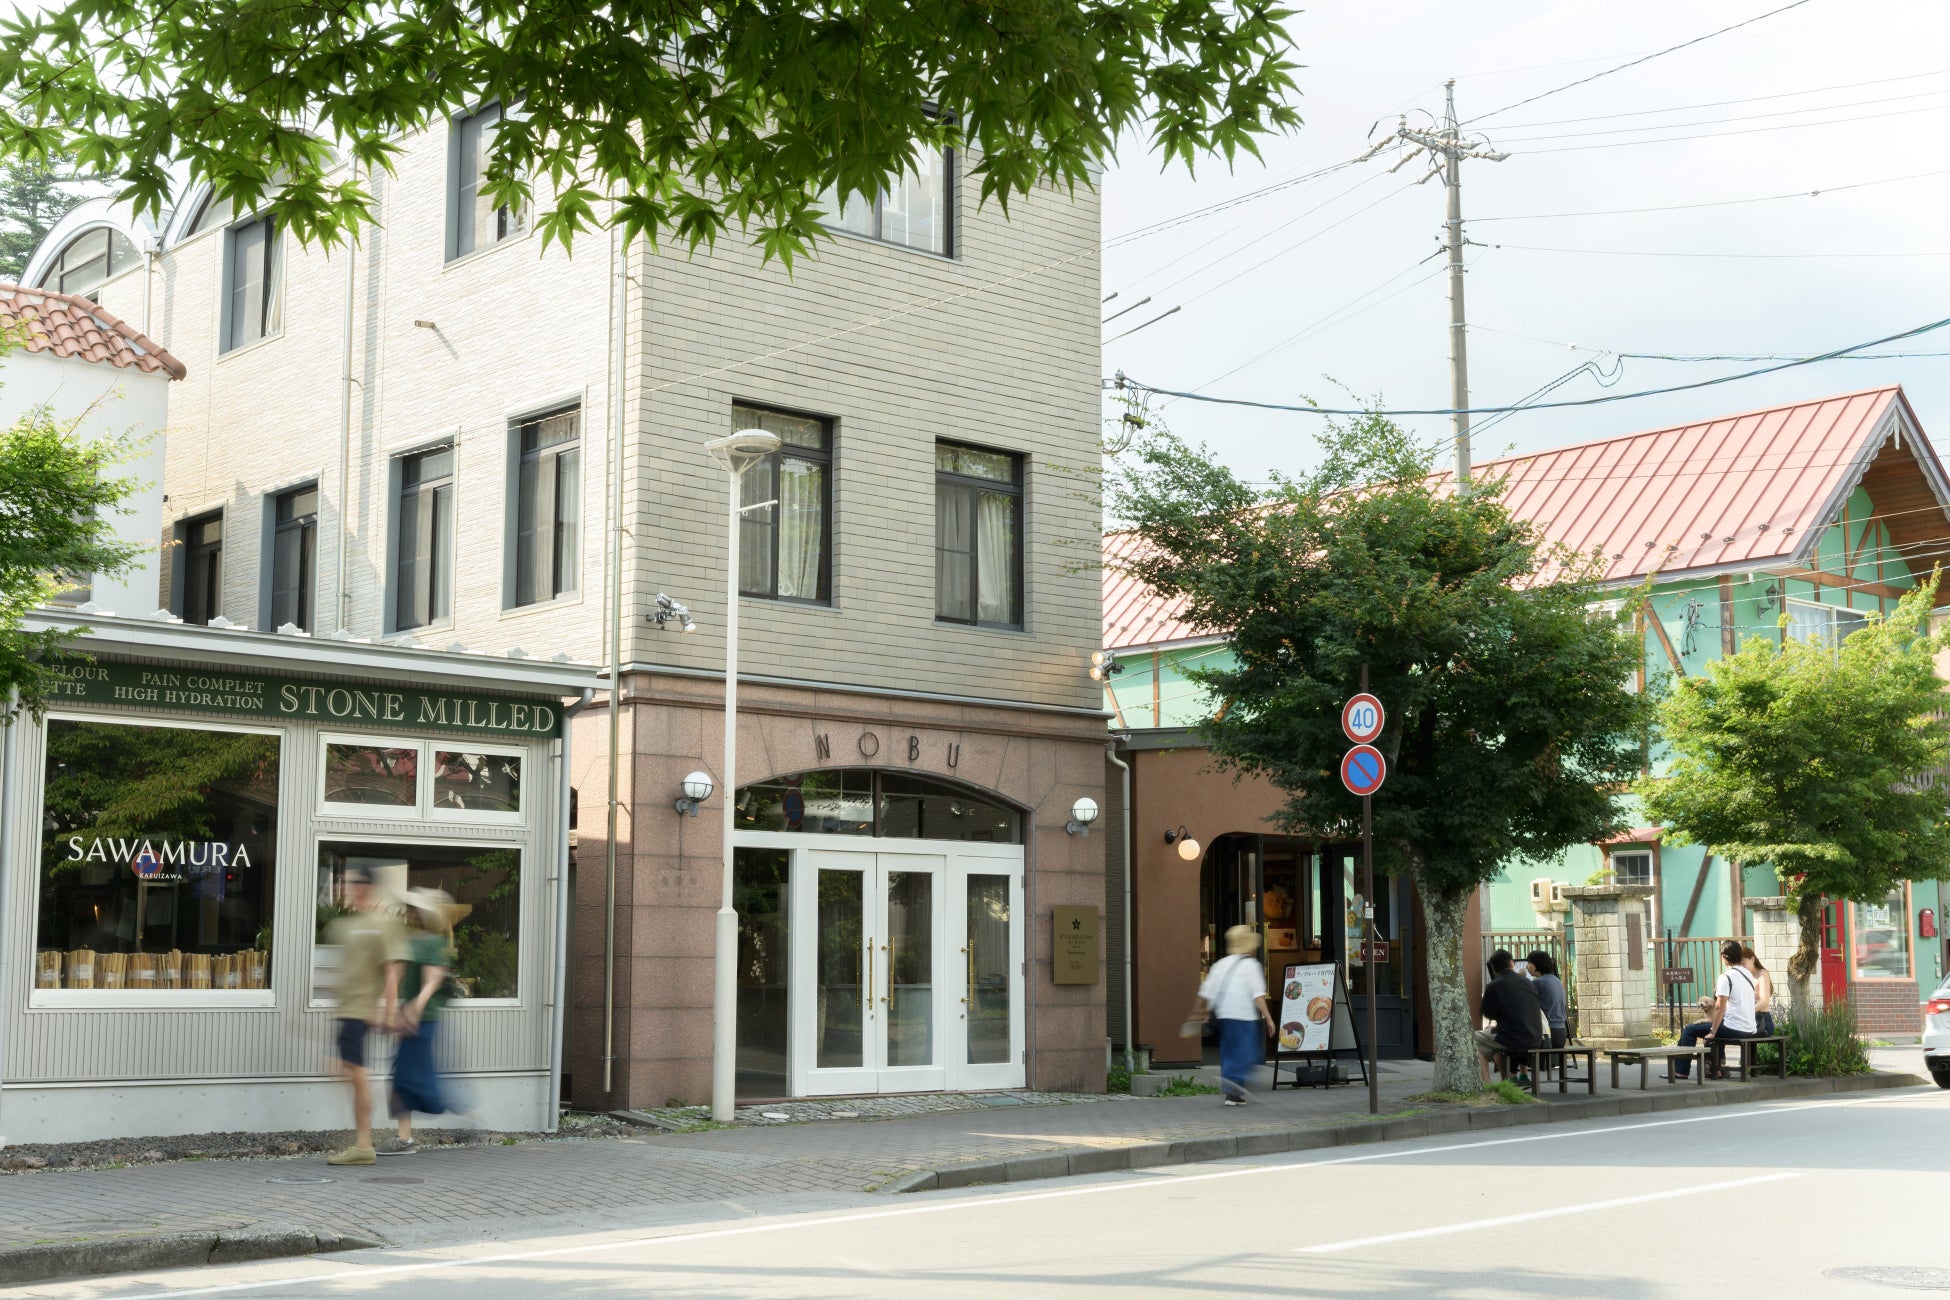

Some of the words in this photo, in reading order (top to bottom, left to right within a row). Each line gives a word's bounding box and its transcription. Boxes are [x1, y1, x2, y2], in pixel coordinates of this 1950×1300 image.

[51, 664, 109, 681] FLOUR
[141, 672, 182, 687] PAIN
[187, 677, 265, 694] COMPLET
[113, 686, 159, 701] HIGH
[165, 690, 264, 710] HYDRATION
[280, 684, 405, 721] STONE
[416, 696, 555, 732] MILLED
[1352, 708, 1374, 729] 40
[815, 732, 960, 768] NOBU
[68, 836, 251, 868] SAWAMURA
[139, 872, 183, 880] KARUIZAWA
[1362, 948, 1385, 956] OEN
